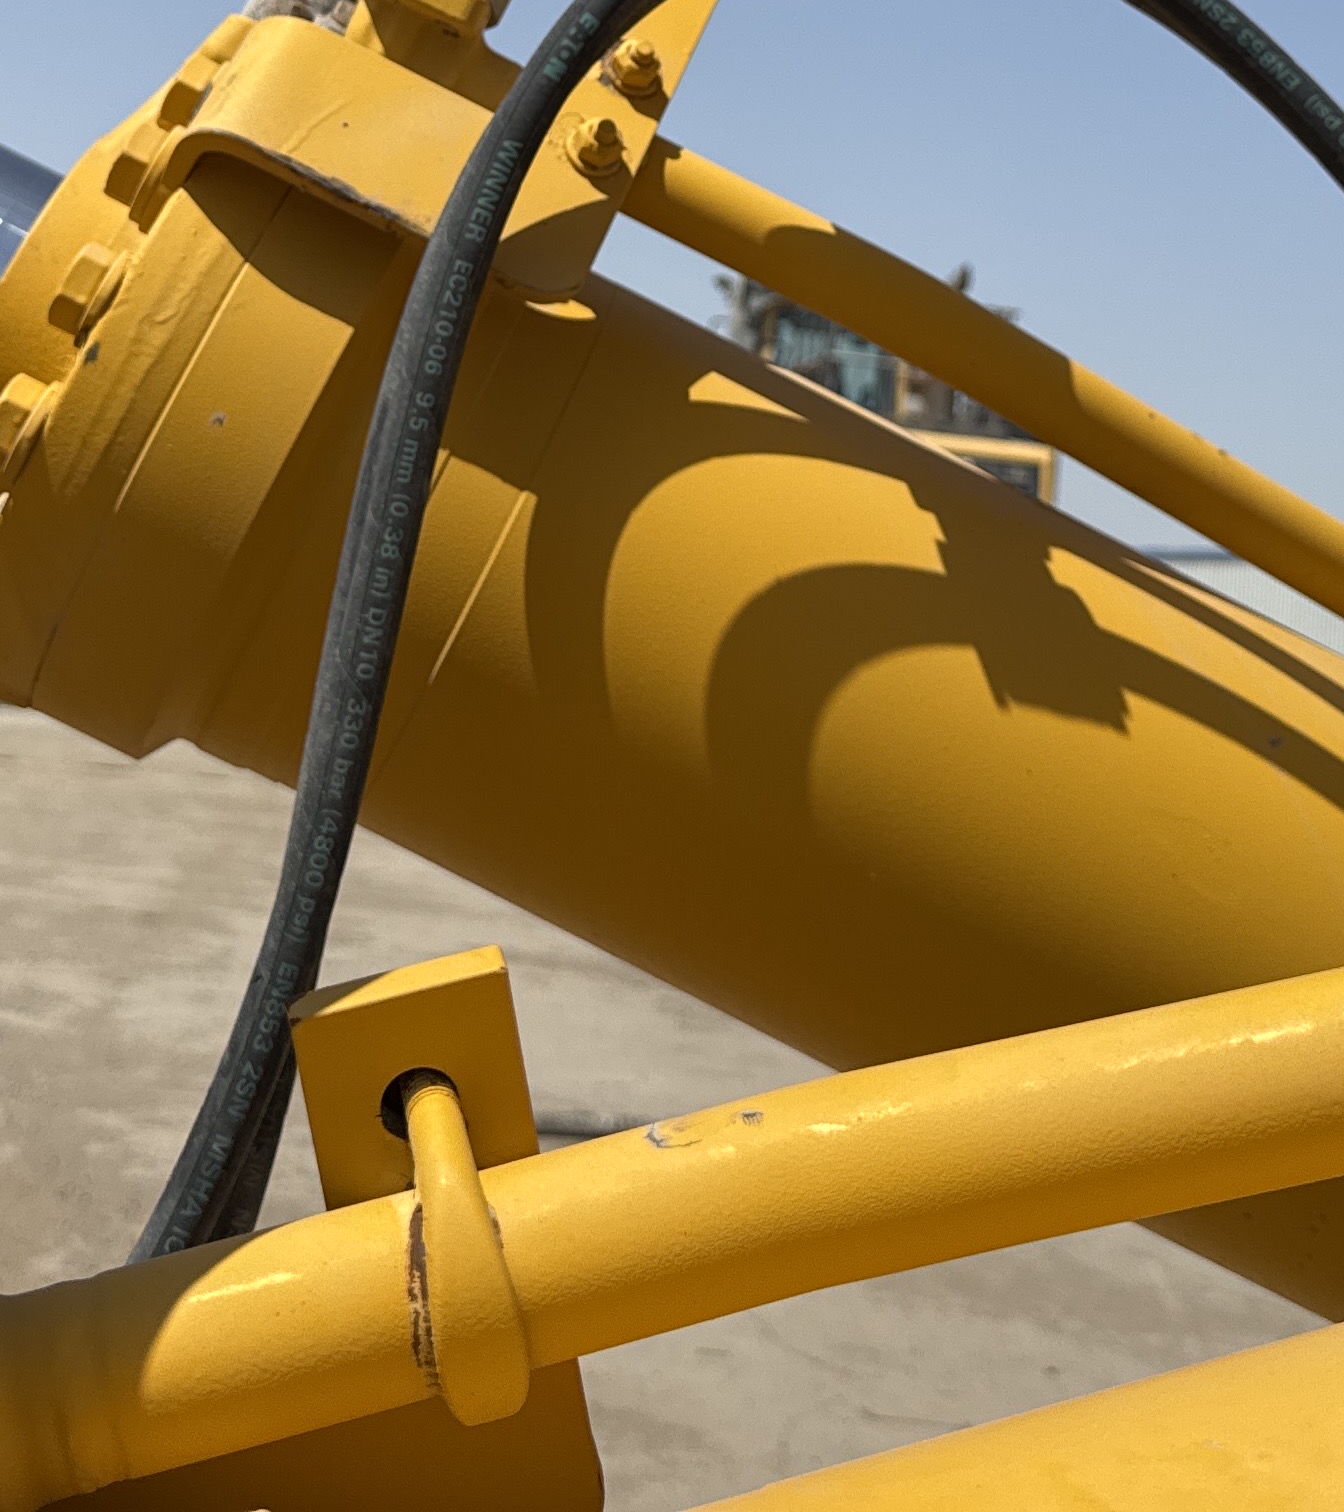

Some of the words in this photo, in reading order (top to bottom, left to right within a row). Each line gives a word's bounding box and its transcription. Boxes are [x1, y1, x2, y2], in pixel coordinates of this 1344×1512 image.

[463, 140, 524, 243] WINNER
[408, 391, 436, 432] 9.5
[396, 439, 419, 483] mm
[379, 493, 412, 560] (0.38
[371, 567, 391, 597] in)
[355, 607, 386, 680] DN10
[339, 698, 366, 749] 330
[330, 757, 352, 800] bar
